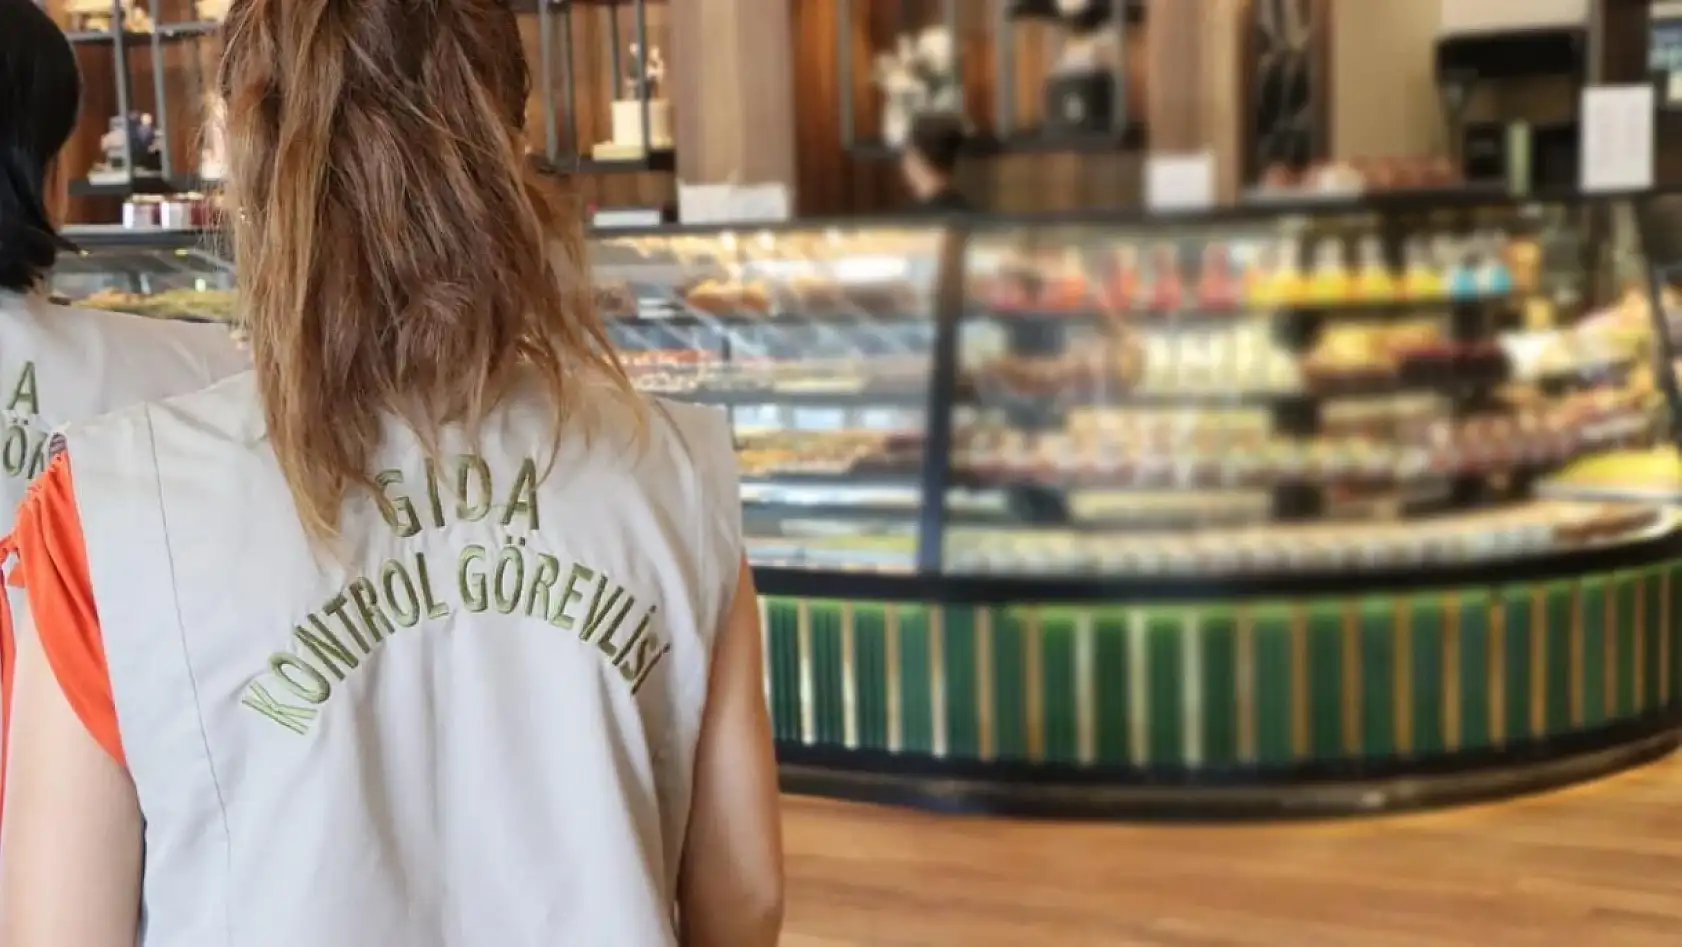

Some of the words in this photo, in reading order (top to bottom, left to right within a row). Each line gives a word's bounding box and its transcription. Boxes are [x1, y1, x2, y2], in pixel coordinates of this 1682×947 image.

[374, 454, 539, 537] GIDA
[242, 552, 449, 735] KONTROL
[458, 536, 671, 696] GÖREVLİSİ
